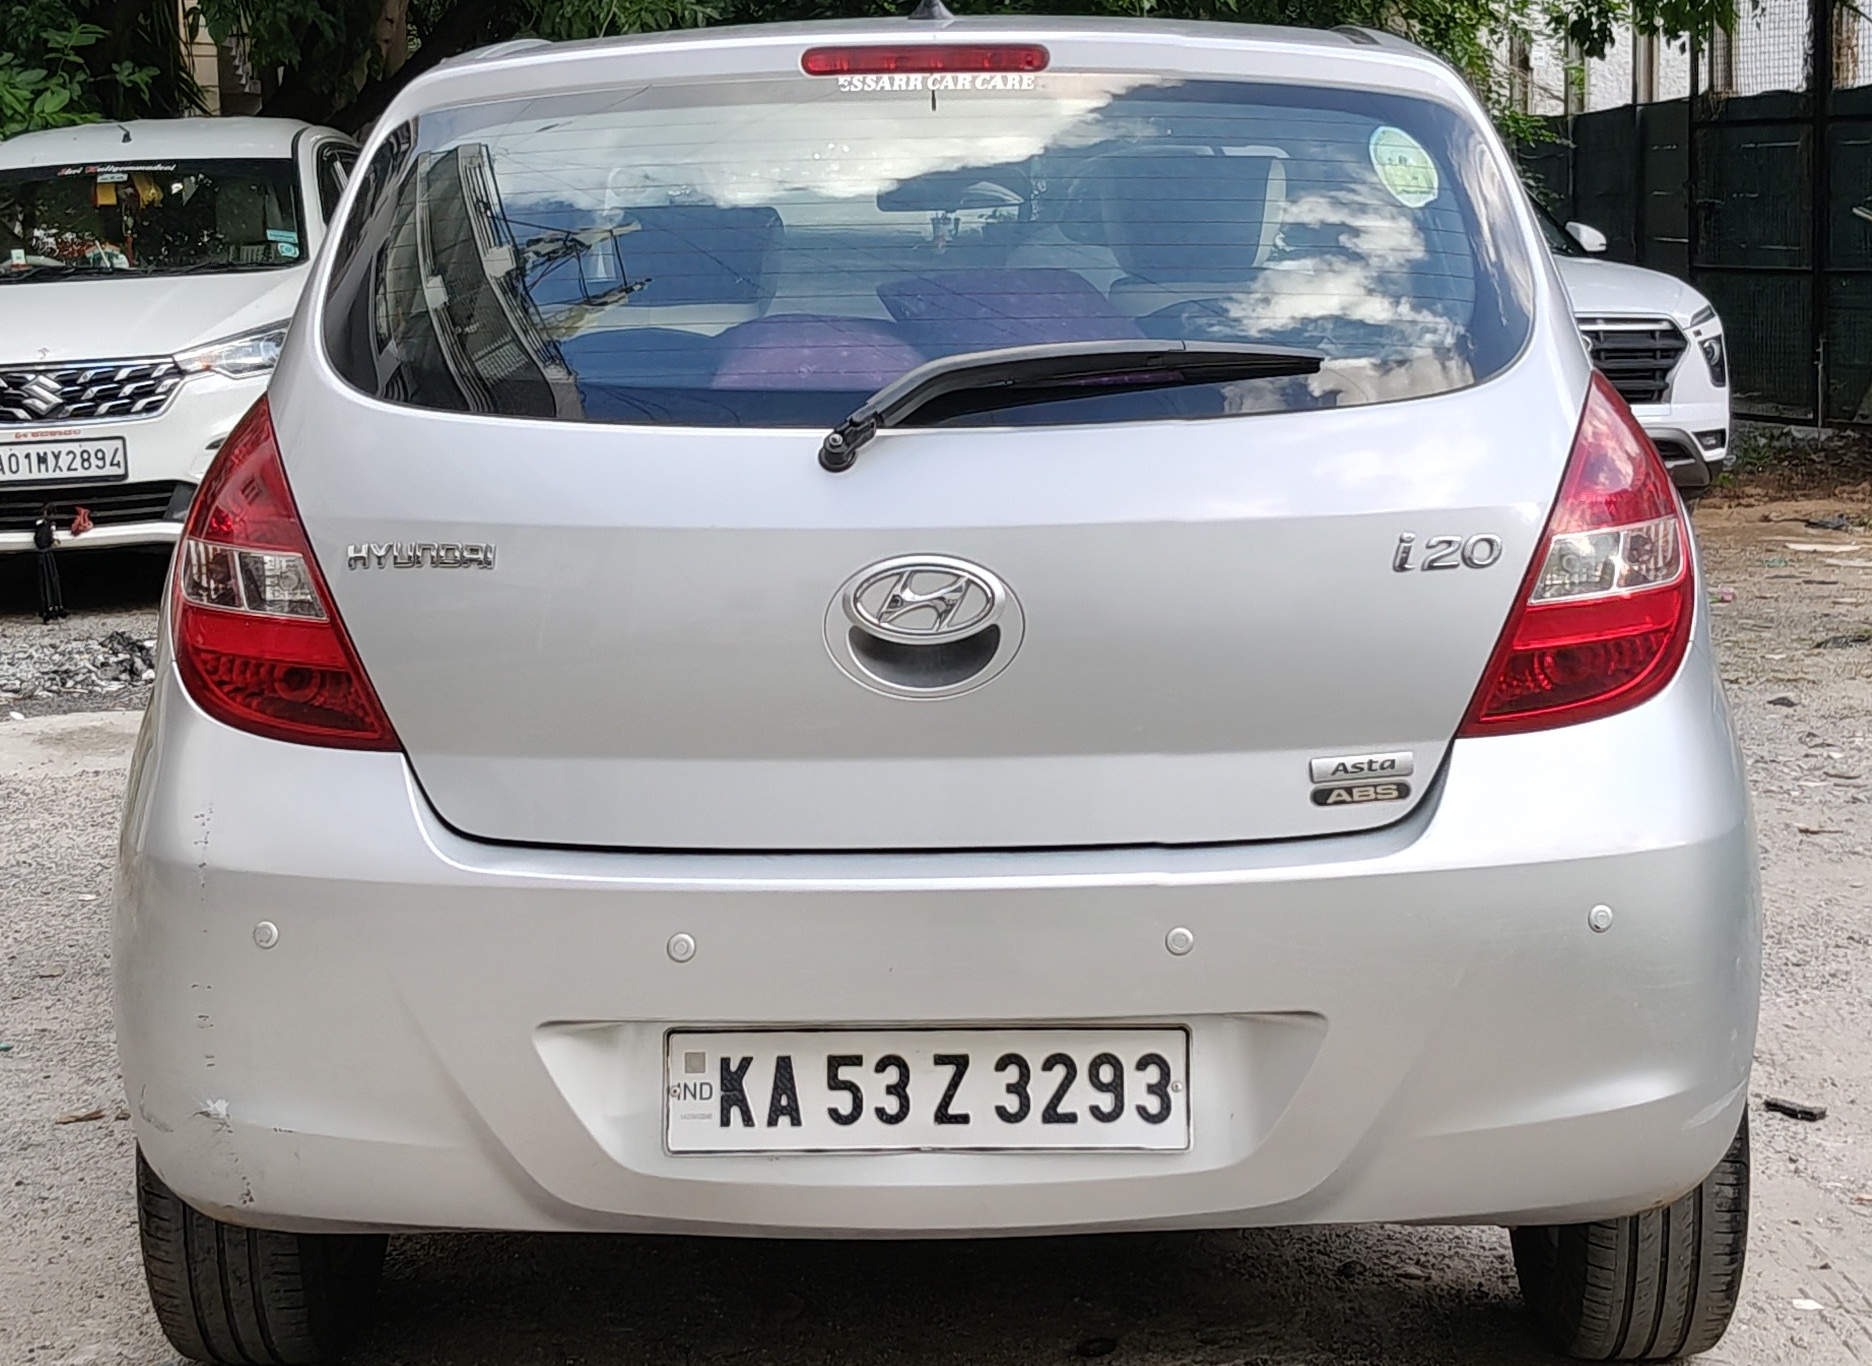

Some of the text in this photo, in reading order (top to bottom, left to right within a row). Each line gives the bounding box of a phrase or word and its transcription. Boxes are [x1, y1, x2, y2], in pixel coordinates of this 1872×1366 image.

[927, 74, 977, 91] CAR
[975, 74, 1036, 90] CARE
[347, 541, 495, 570] HYUNDAI
[1392, 532, 1502, 573] i20
[1330, 758, 1397, 776] Asta
[1326, 784, 1400, 804] ABS
[719, 1052, 1173, 1128] KA 53 Z 3293
